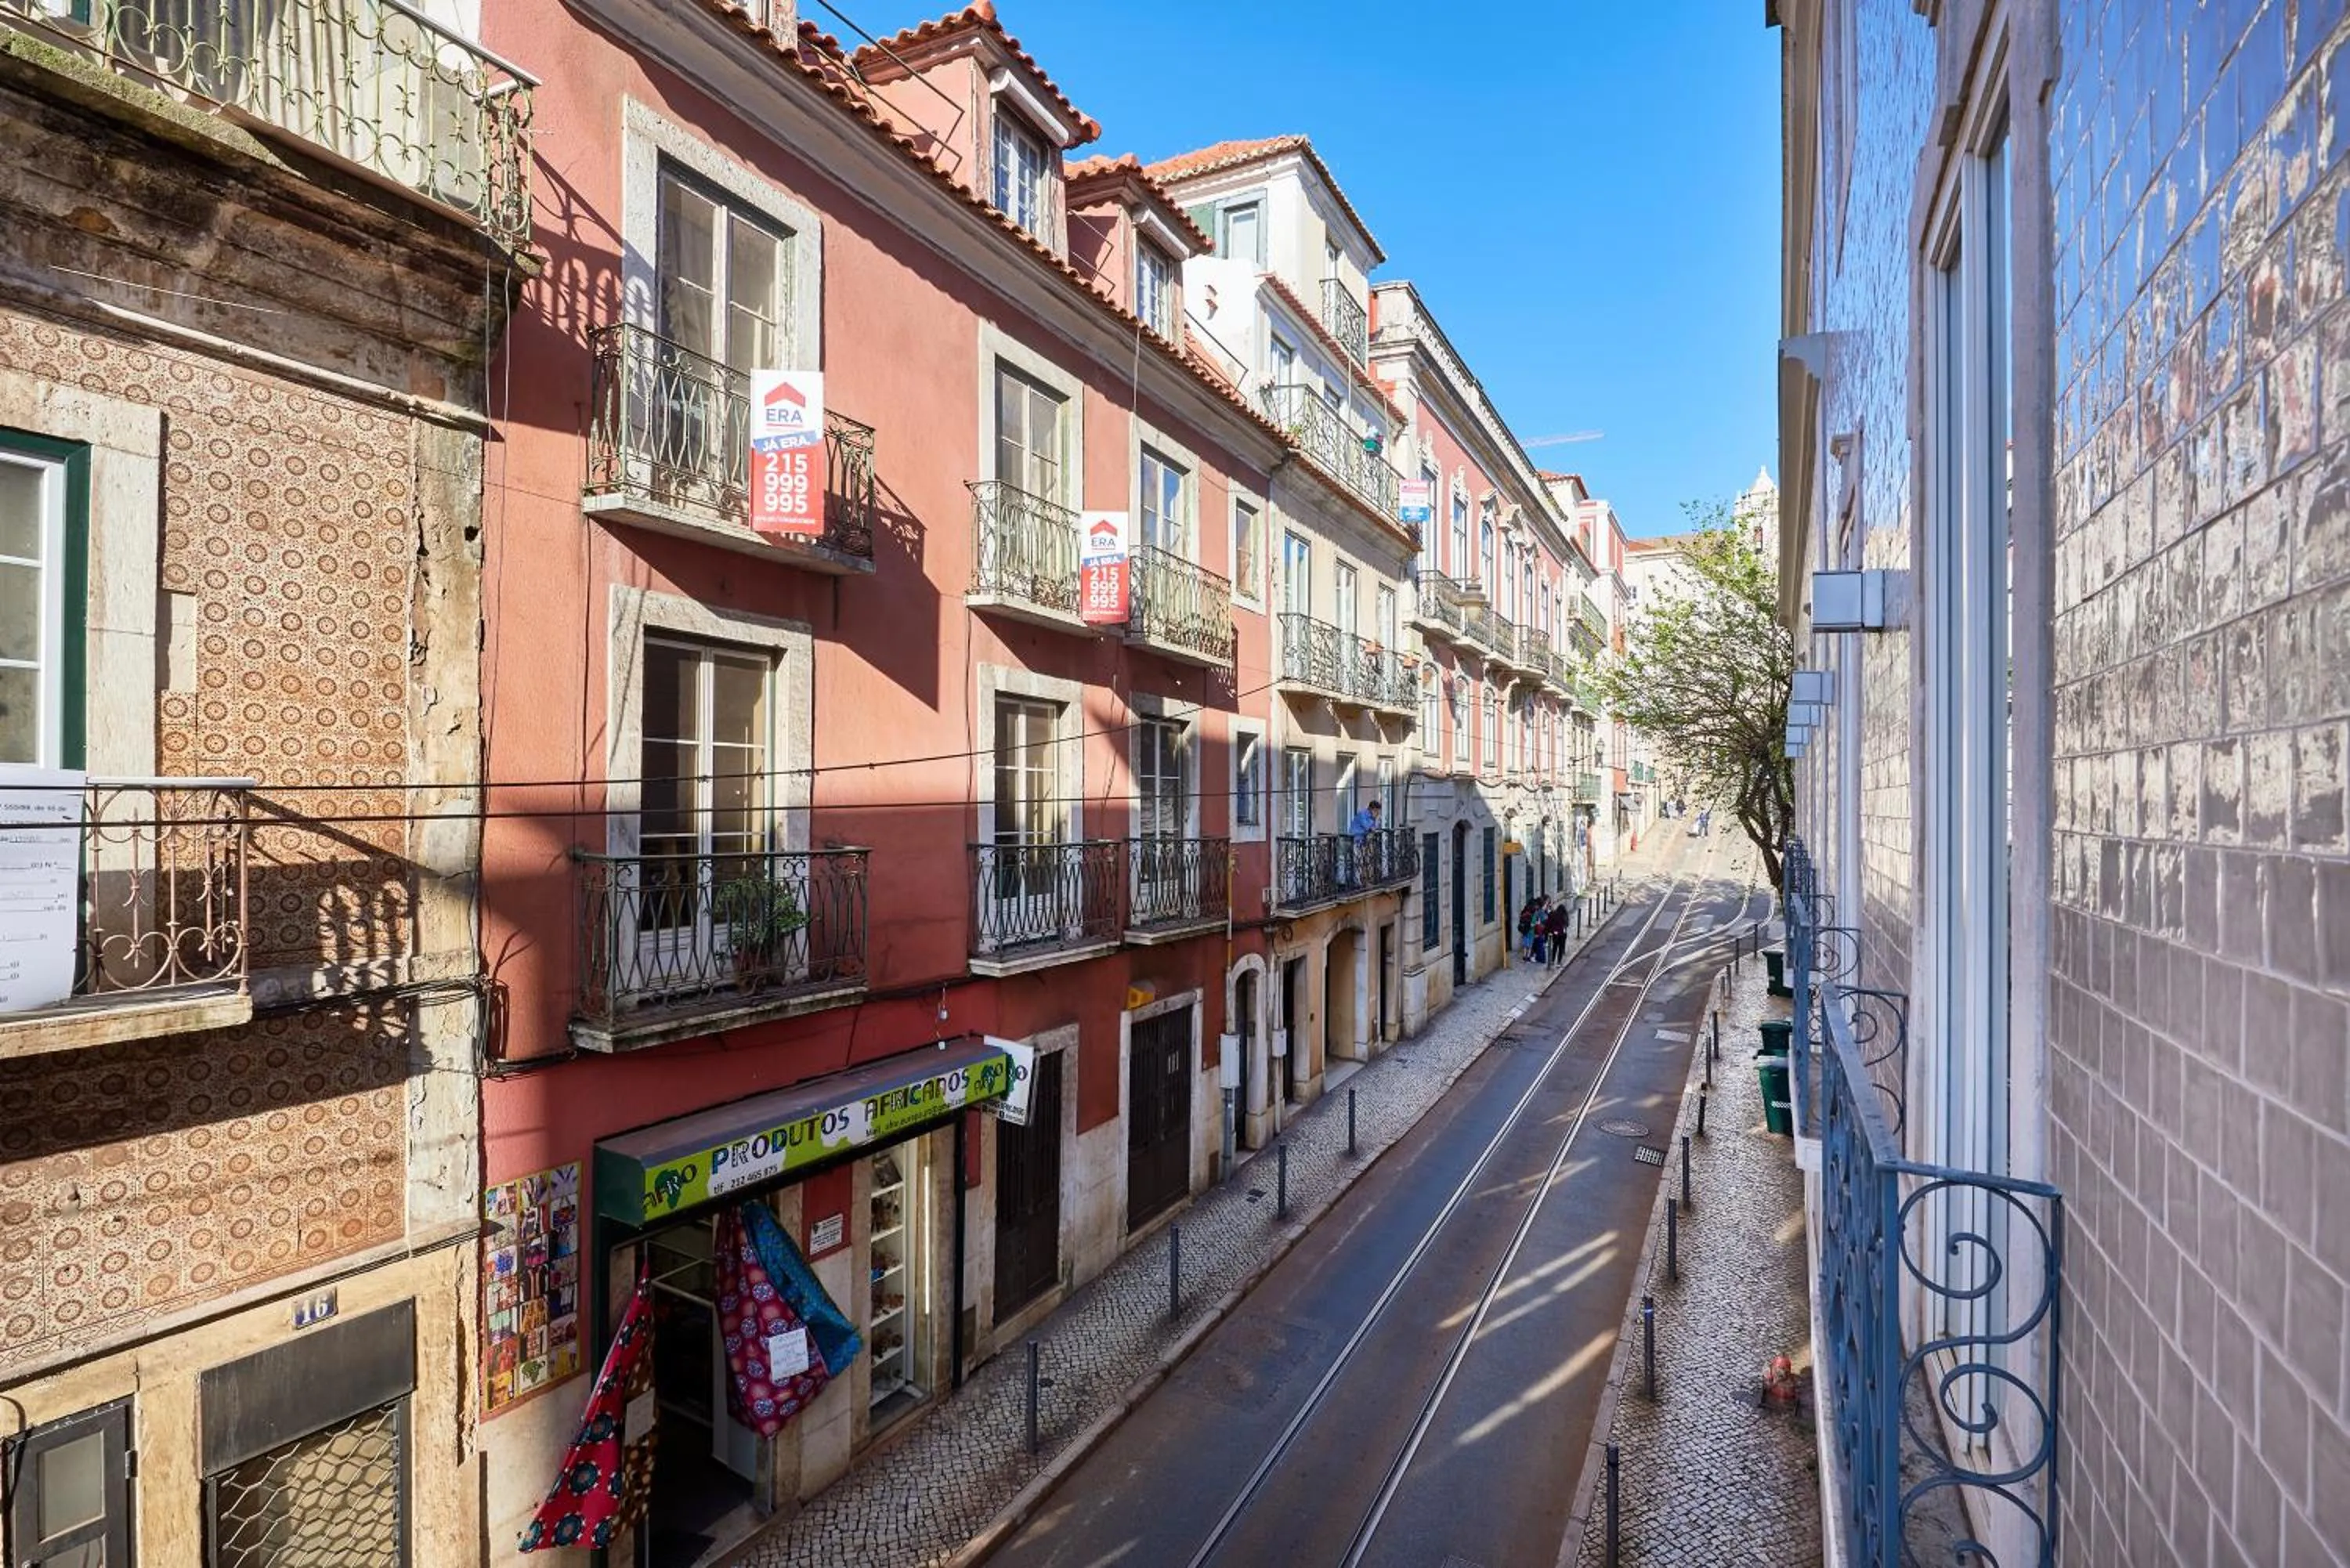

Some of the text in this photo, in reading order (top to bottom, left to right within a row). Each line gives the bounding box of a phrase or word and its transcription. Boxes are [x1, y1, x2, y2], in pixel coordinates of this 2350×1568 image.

[765, 408, 803, 423] ERA
[765, 452, 808, 473] 215
[764, 472, 808, 493] 999
[764, 493, 808, 514] 995
[1091, 537, 1116, 547] ERA
[1090, 566, 1119, 580] 215
[1090, 580, 1119, 594] 999
[1090, 594, 1119, 608] 995
[712, 1107, 850, 1175] PRODUTOS
[302, 1294, 328, 1324] 16
